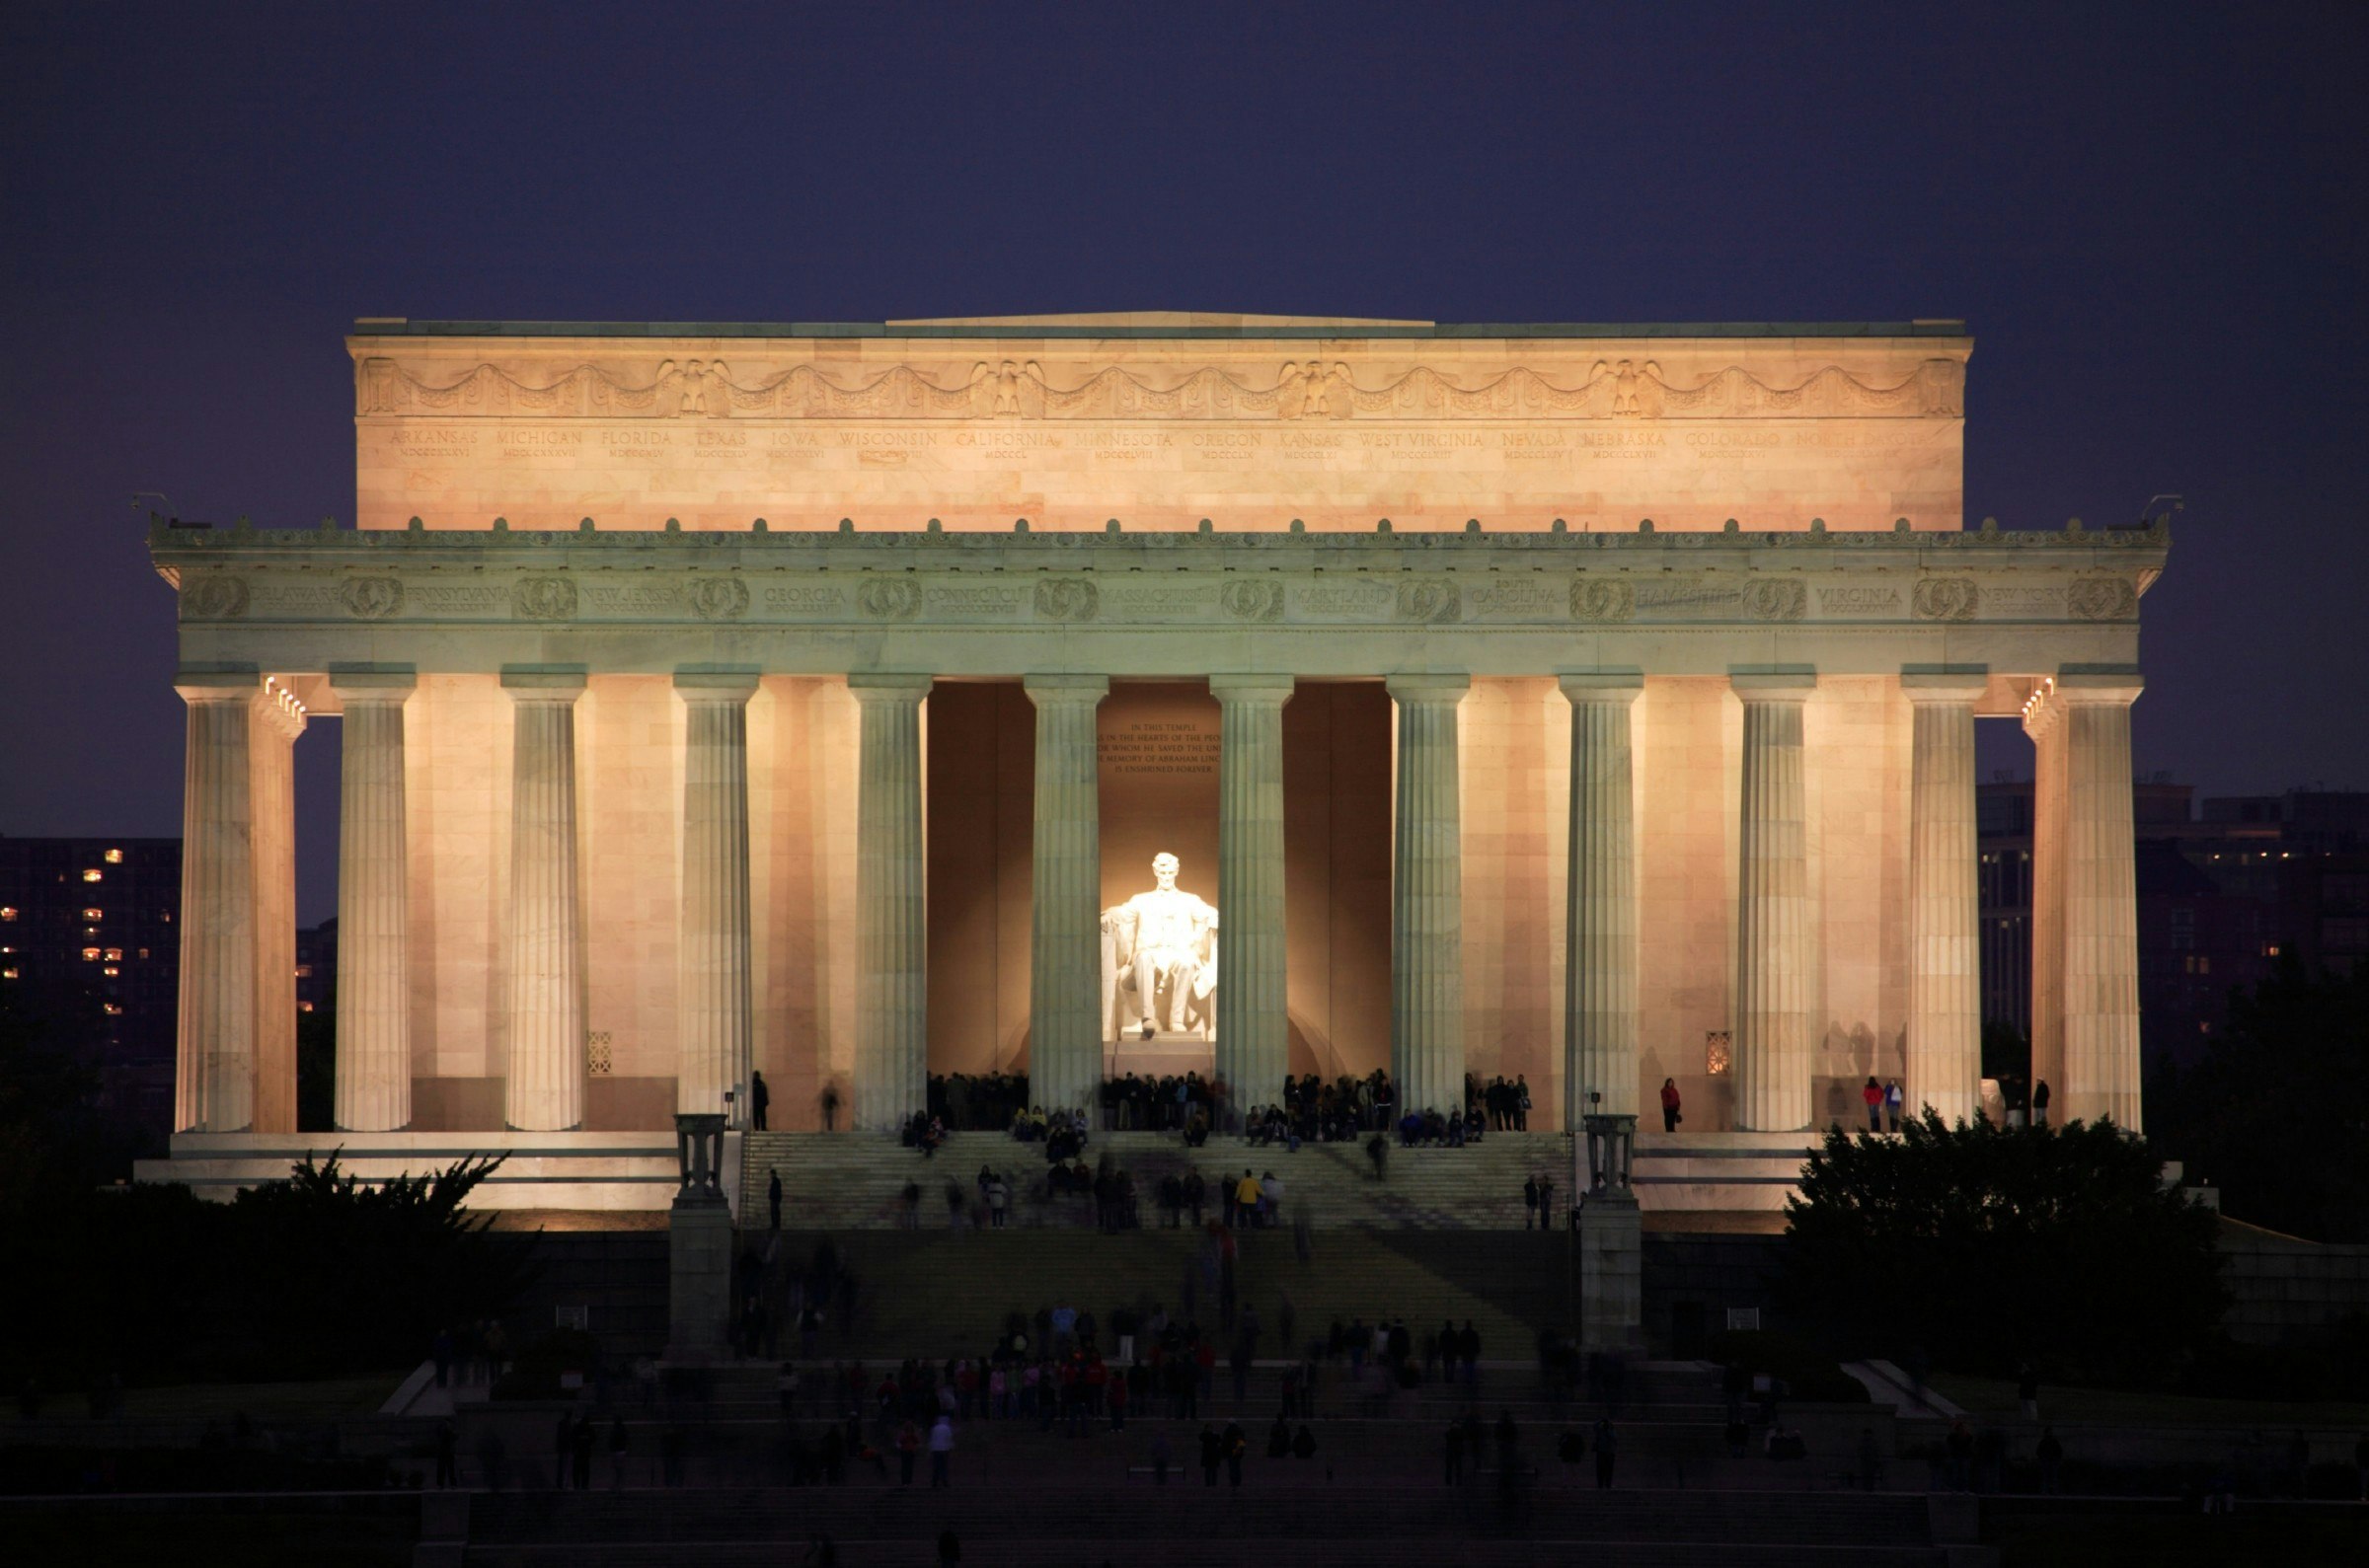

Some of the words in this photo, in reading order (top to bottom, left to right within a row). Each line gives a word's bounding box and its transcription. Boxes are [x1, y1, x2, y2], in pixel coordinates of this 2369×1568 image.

[389, 430, 478, 444] ARKANSAS
[497, 431, 582, 444] MICHIGAN
[602, 431, 672, 444] FLORIDA
[695, 431, 747, 445] TEXAS
[772, 432, 818, 445] IOWA
[839, 432, 937, 445] WISCONSIN
[955, 432, 1054, 446] CALIFORNIA
[1075, 433, 1173, 446] MINNESOTA
[1192, 433, 1261, 446] OREGON
[1279, 433, 1342, 446] KANSAS
[1359, 432, 1403, 446] WEST
[1408, 432, 1484, 446] VIRGINIA
[1501, 432, 1567, 446] NEVADA
[1583, 432, 1666, 446] NEBRASKA
[1686, 432, 1781, 446] COLORADO
[1796, 432, 1855, 446] NORTH
[985, 450, 1028, 459] MDCCCL
[1495, 579, 1535, 588] SOUTH
[406, 587, 511, 602] PENNSYLVANIA
[582, 587, 620, 602] NEW
[623, 587, 680, 602] JERSEY
[765, 588, 846, 603] GEORGIA
[926, 586, 1032, 603] CONNECTICUT
[1292, 589, 1390, 604] MARYLAND
[1471, 589, 1557, 604] CAROLINA
[1816, 588, 1902, 603] VIRGINIA
[1979, 588, 2018, 602] NEW
[2021, 588, 2069, 602] YORK
